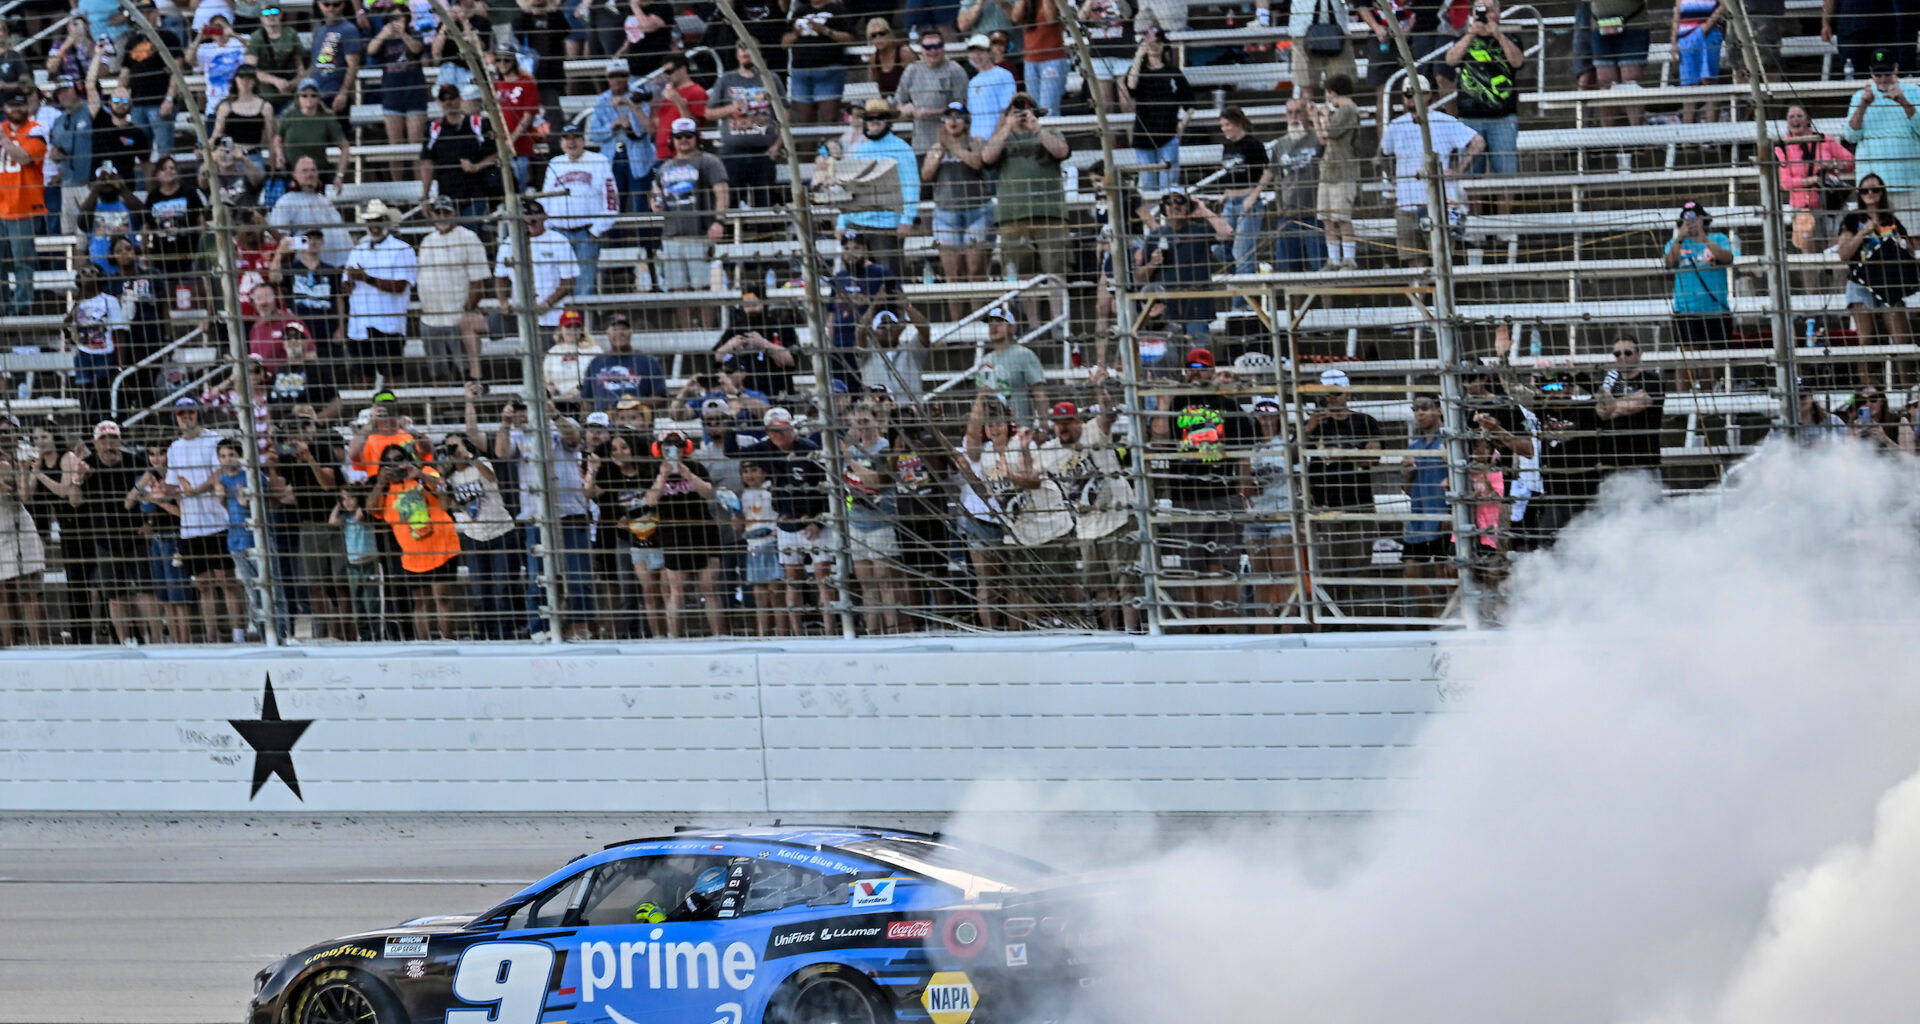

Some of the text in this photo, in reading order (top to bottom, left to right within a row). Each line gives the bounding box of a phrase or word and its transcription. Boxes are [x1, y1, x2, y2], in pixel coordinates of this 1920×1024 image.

[777, 848, 860, 876] Kelley Blue Book
[856, 897, 888, 905] Valvoline
[400, 936, 424, 944] NASCAR
[774, 931, 816, 947] UniFirst
[887, 921, 932, 938] Coca-Cola
[304, 944, 378, 966] GOODYEAR
[580, 928, 756, 1002] prime
[447, 940, 555, 1024] 9
[931, 986, 971, 1011] NAPA
